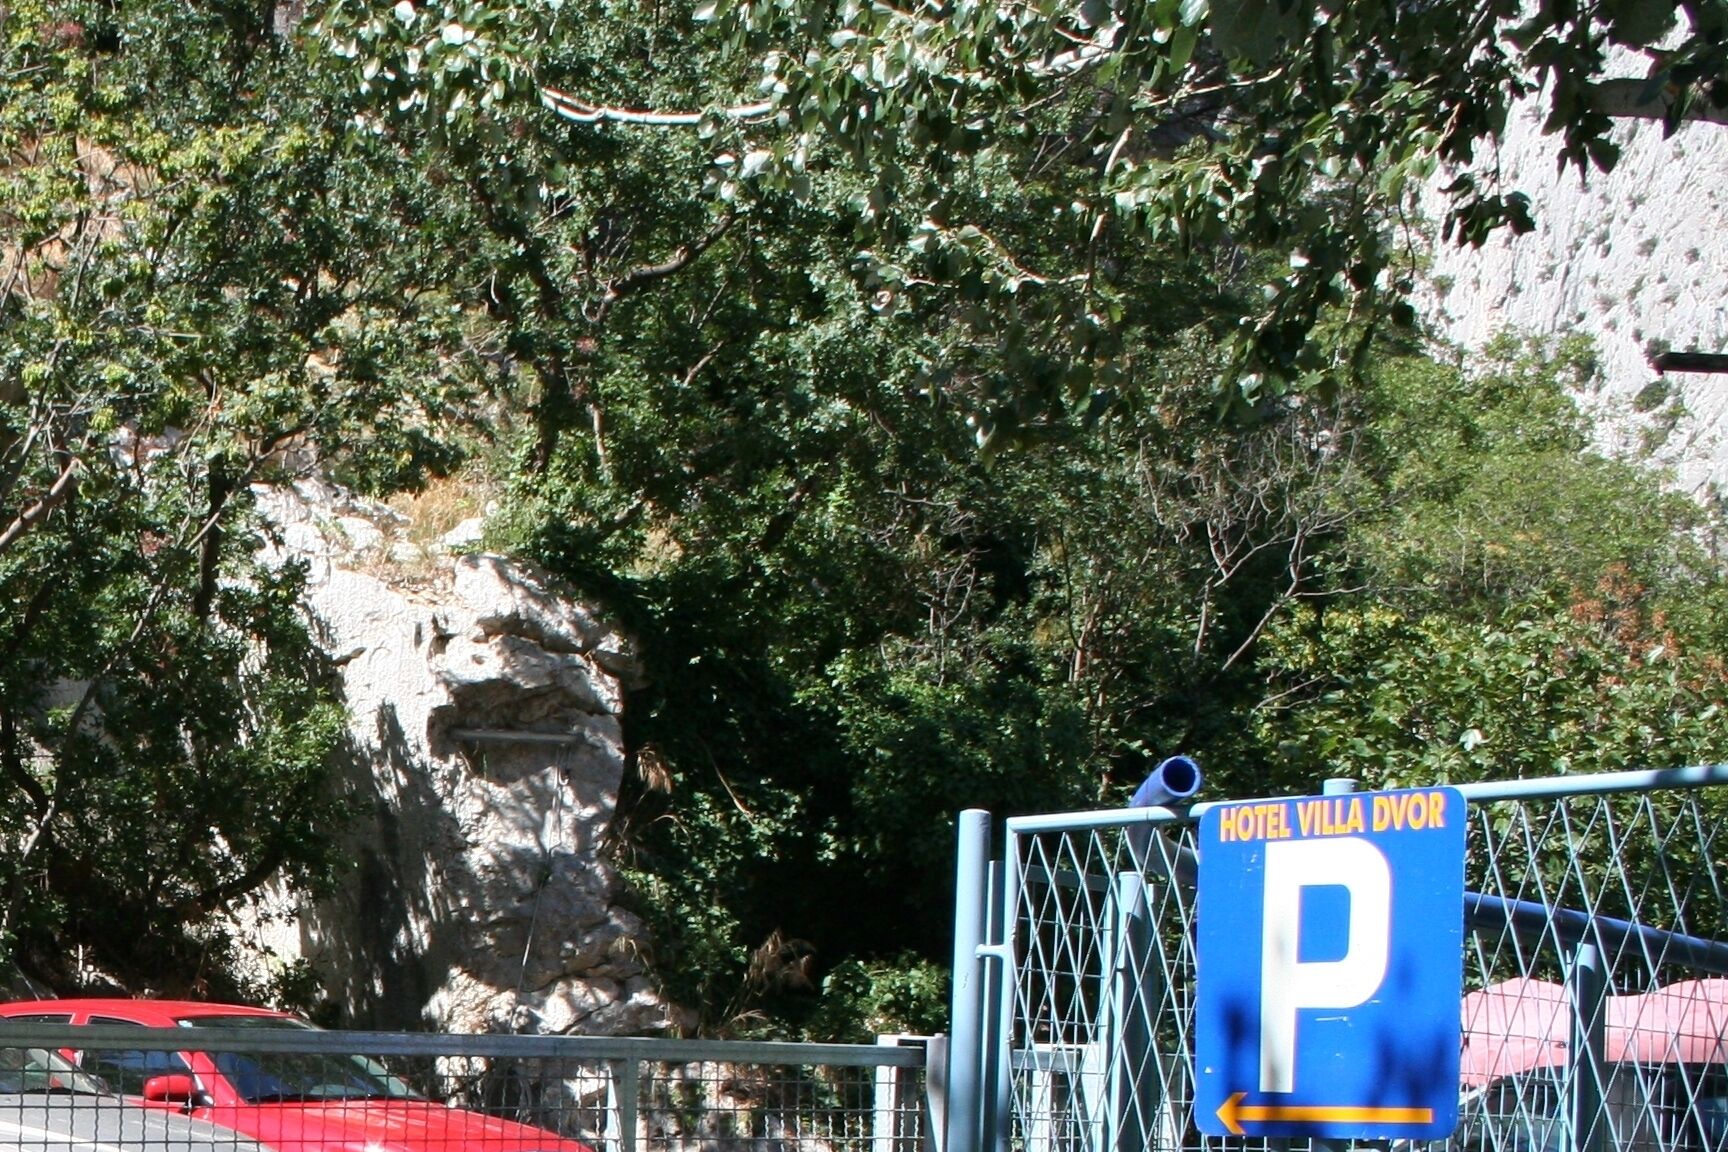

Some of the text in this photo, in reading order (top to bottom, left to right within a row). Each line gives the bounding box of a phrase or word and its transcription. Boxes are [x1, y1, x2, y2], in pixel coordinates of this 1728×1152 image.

[1220, 791, 1447, 842] HOTEL VILLA DVOR
[1259, 837, 1391, 1093] P
